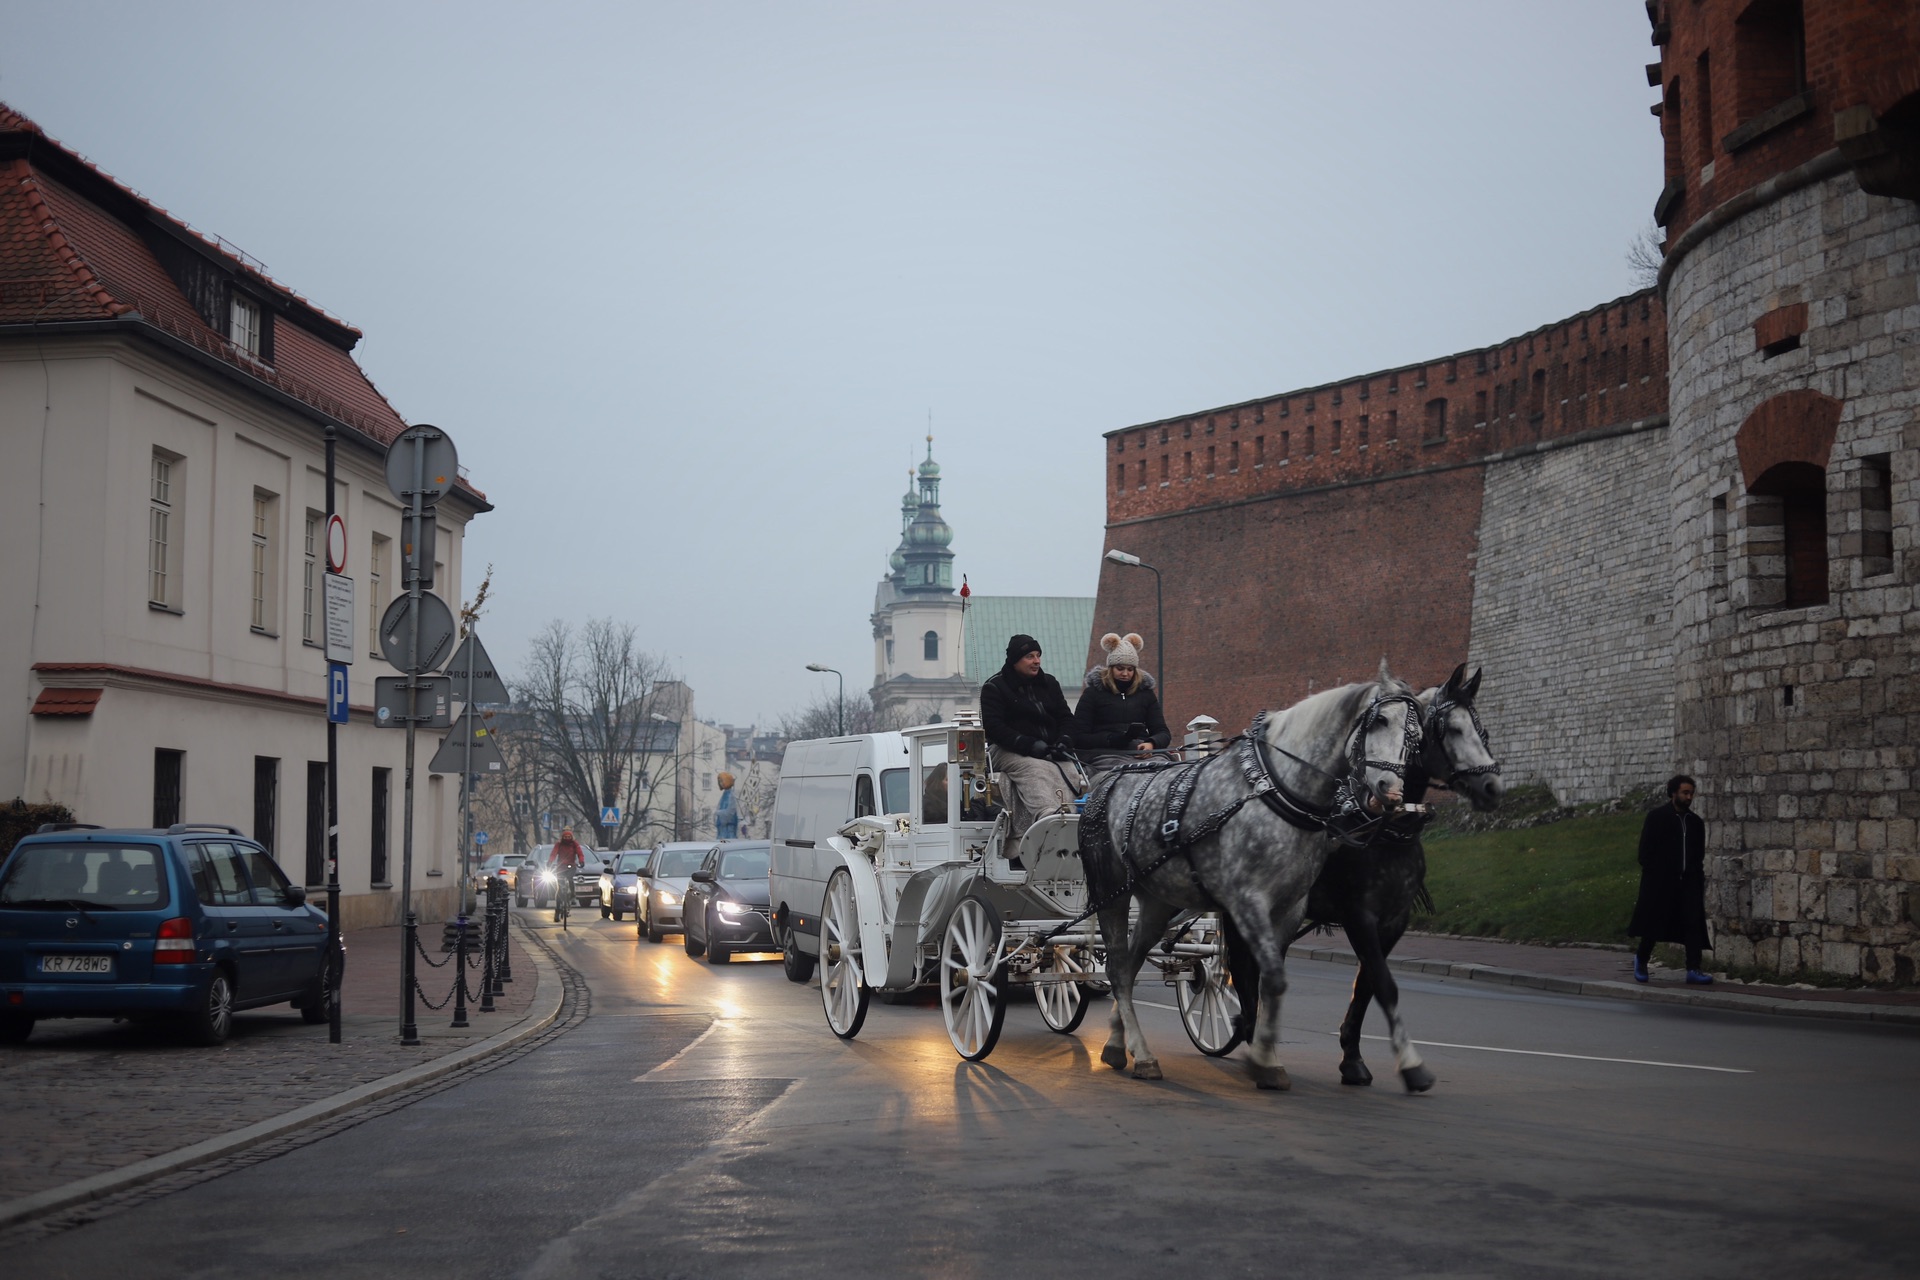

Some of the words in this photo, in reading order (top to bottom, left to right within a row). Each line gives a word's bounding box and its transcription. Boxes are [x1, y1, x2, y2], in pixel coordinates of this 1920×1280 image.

[333, 671, 344, 715] P
[44, 957, 63, 970] KR
[67, 957, 108, 971] 728WG
